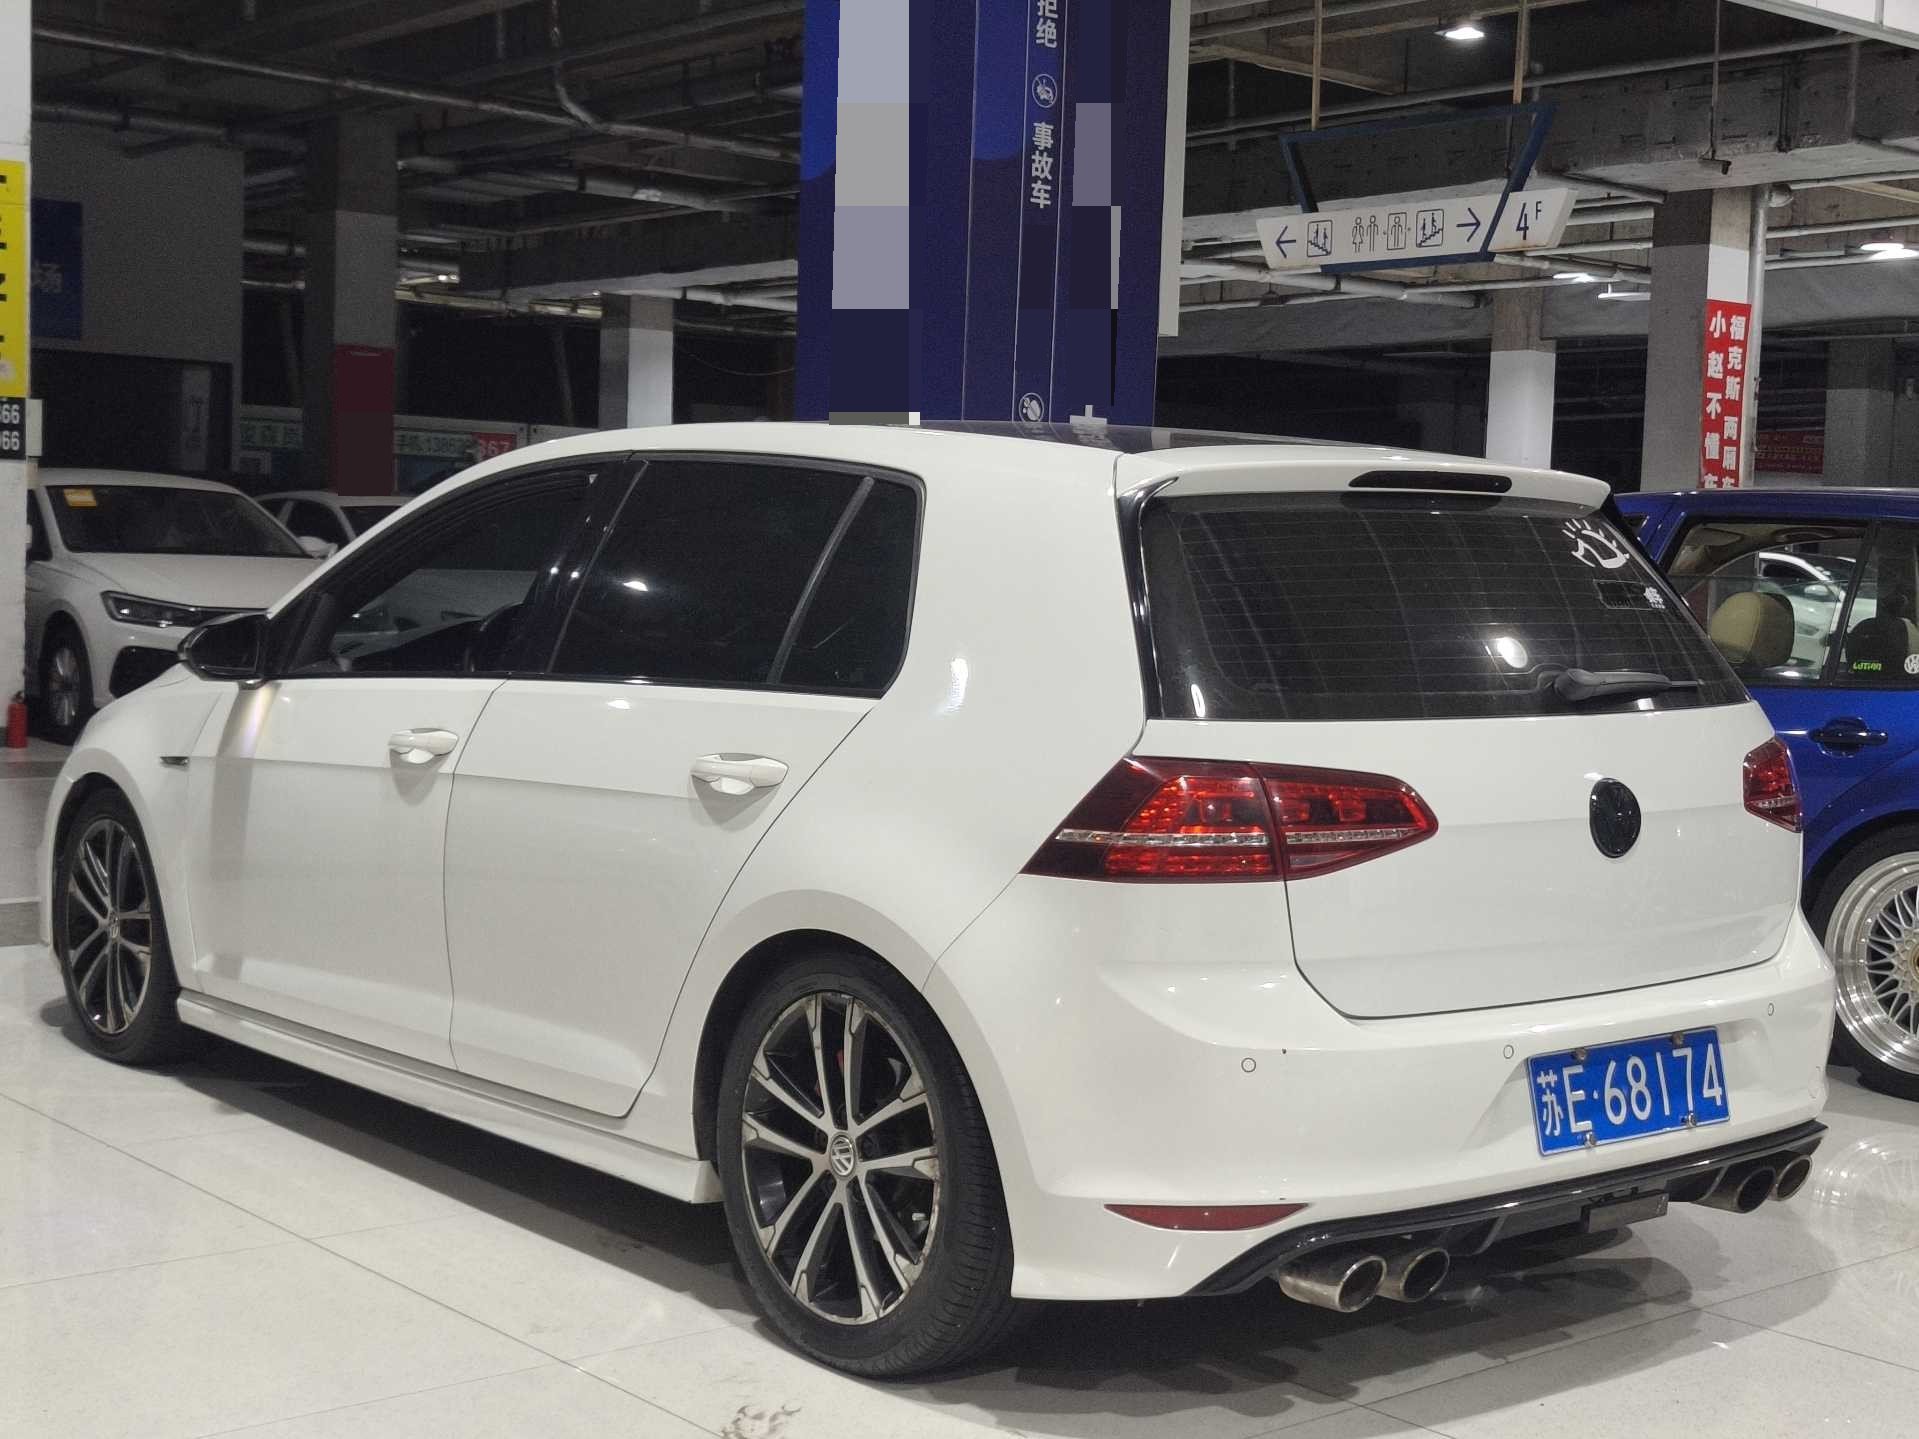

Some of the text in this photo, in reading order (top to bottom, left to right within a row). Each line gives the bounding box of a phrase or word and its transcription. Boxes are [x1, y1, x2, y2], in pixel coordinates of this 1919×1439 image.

[1030, 122, 1054, 208] 事故车
[1516, 201, 1543, 240] 4F
